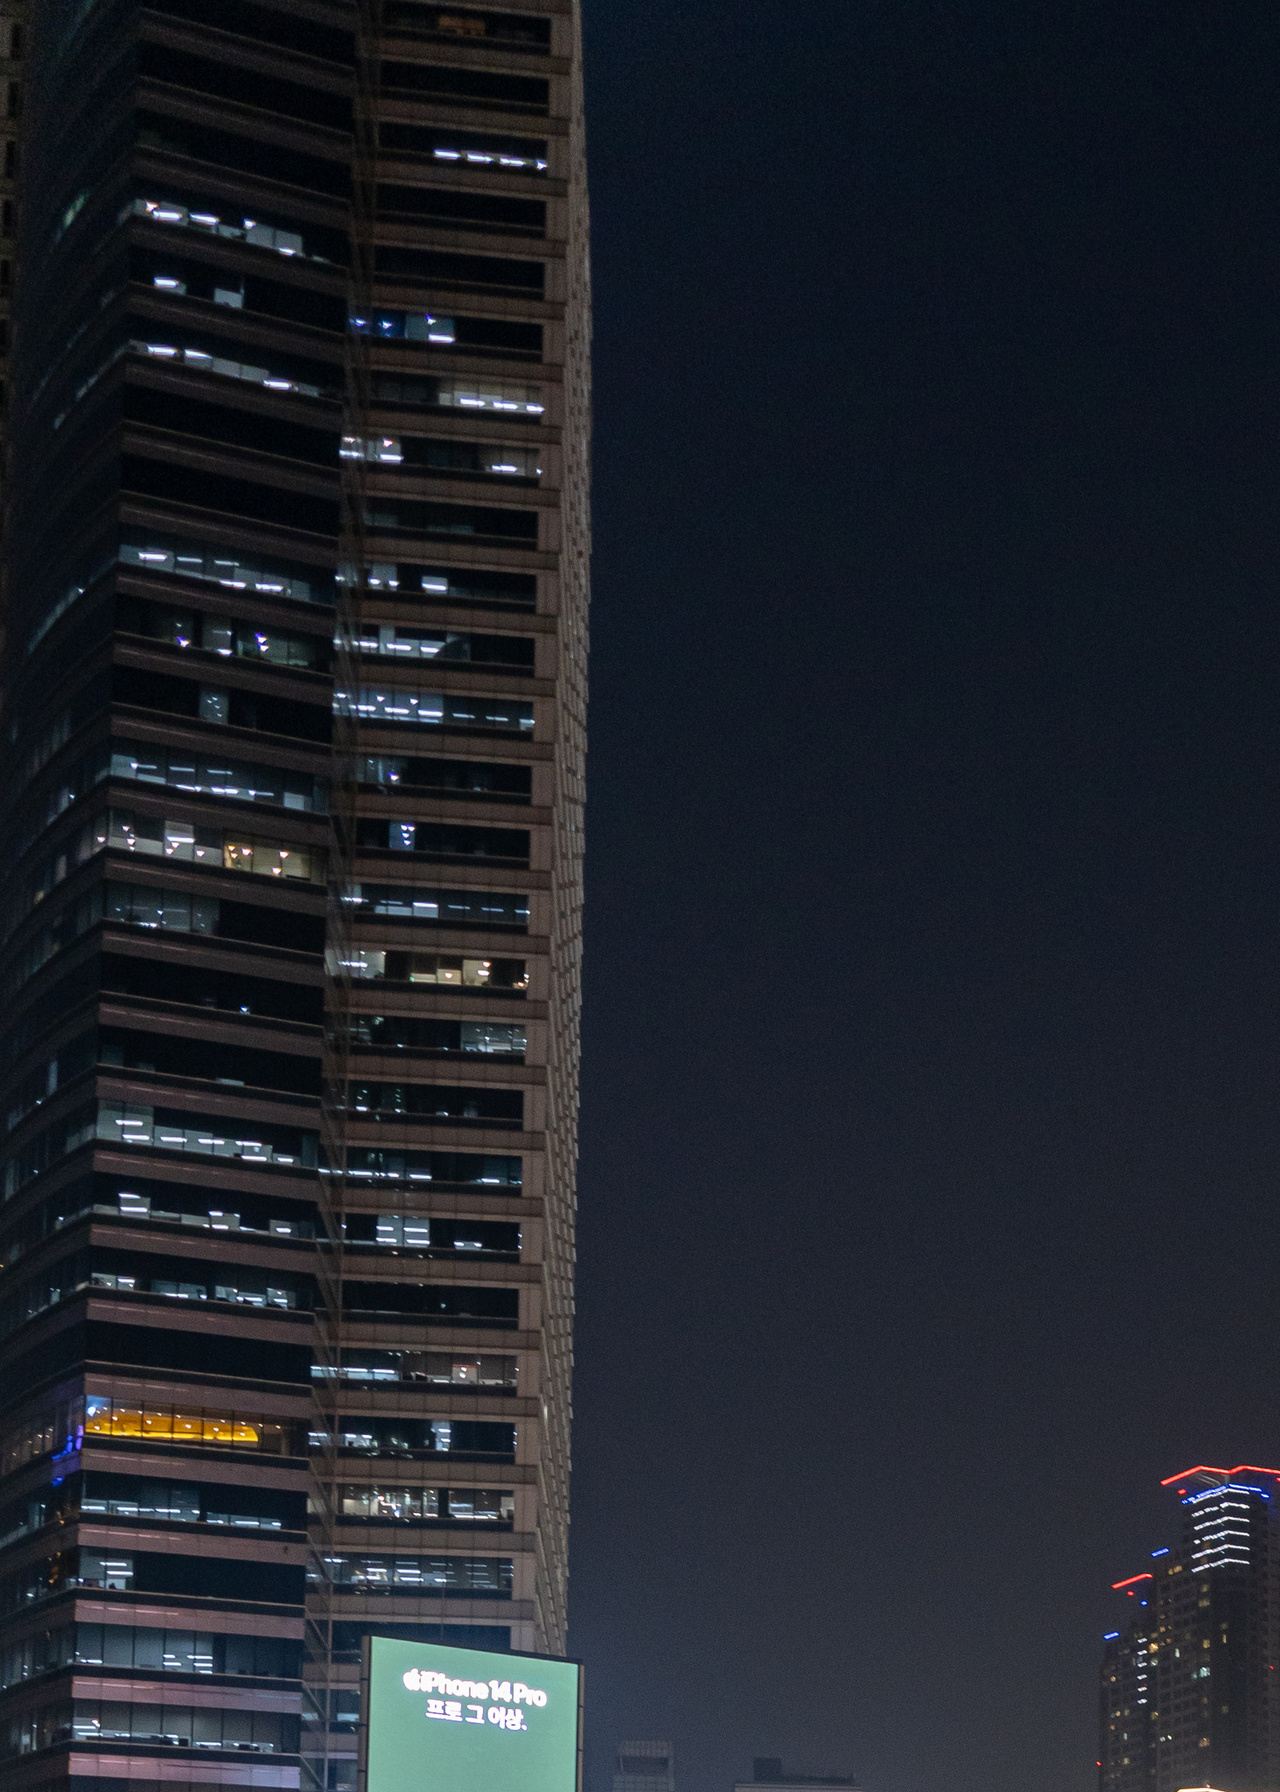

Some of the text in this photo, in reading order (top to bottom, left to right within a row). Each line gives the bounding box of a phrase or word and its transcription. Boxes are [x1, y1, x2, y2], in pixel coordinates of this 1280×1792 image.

[420, 1670, 548, 1707] iPhone 14 Pro
[425, 1699, 528, 1731] 프로 그 이상.
